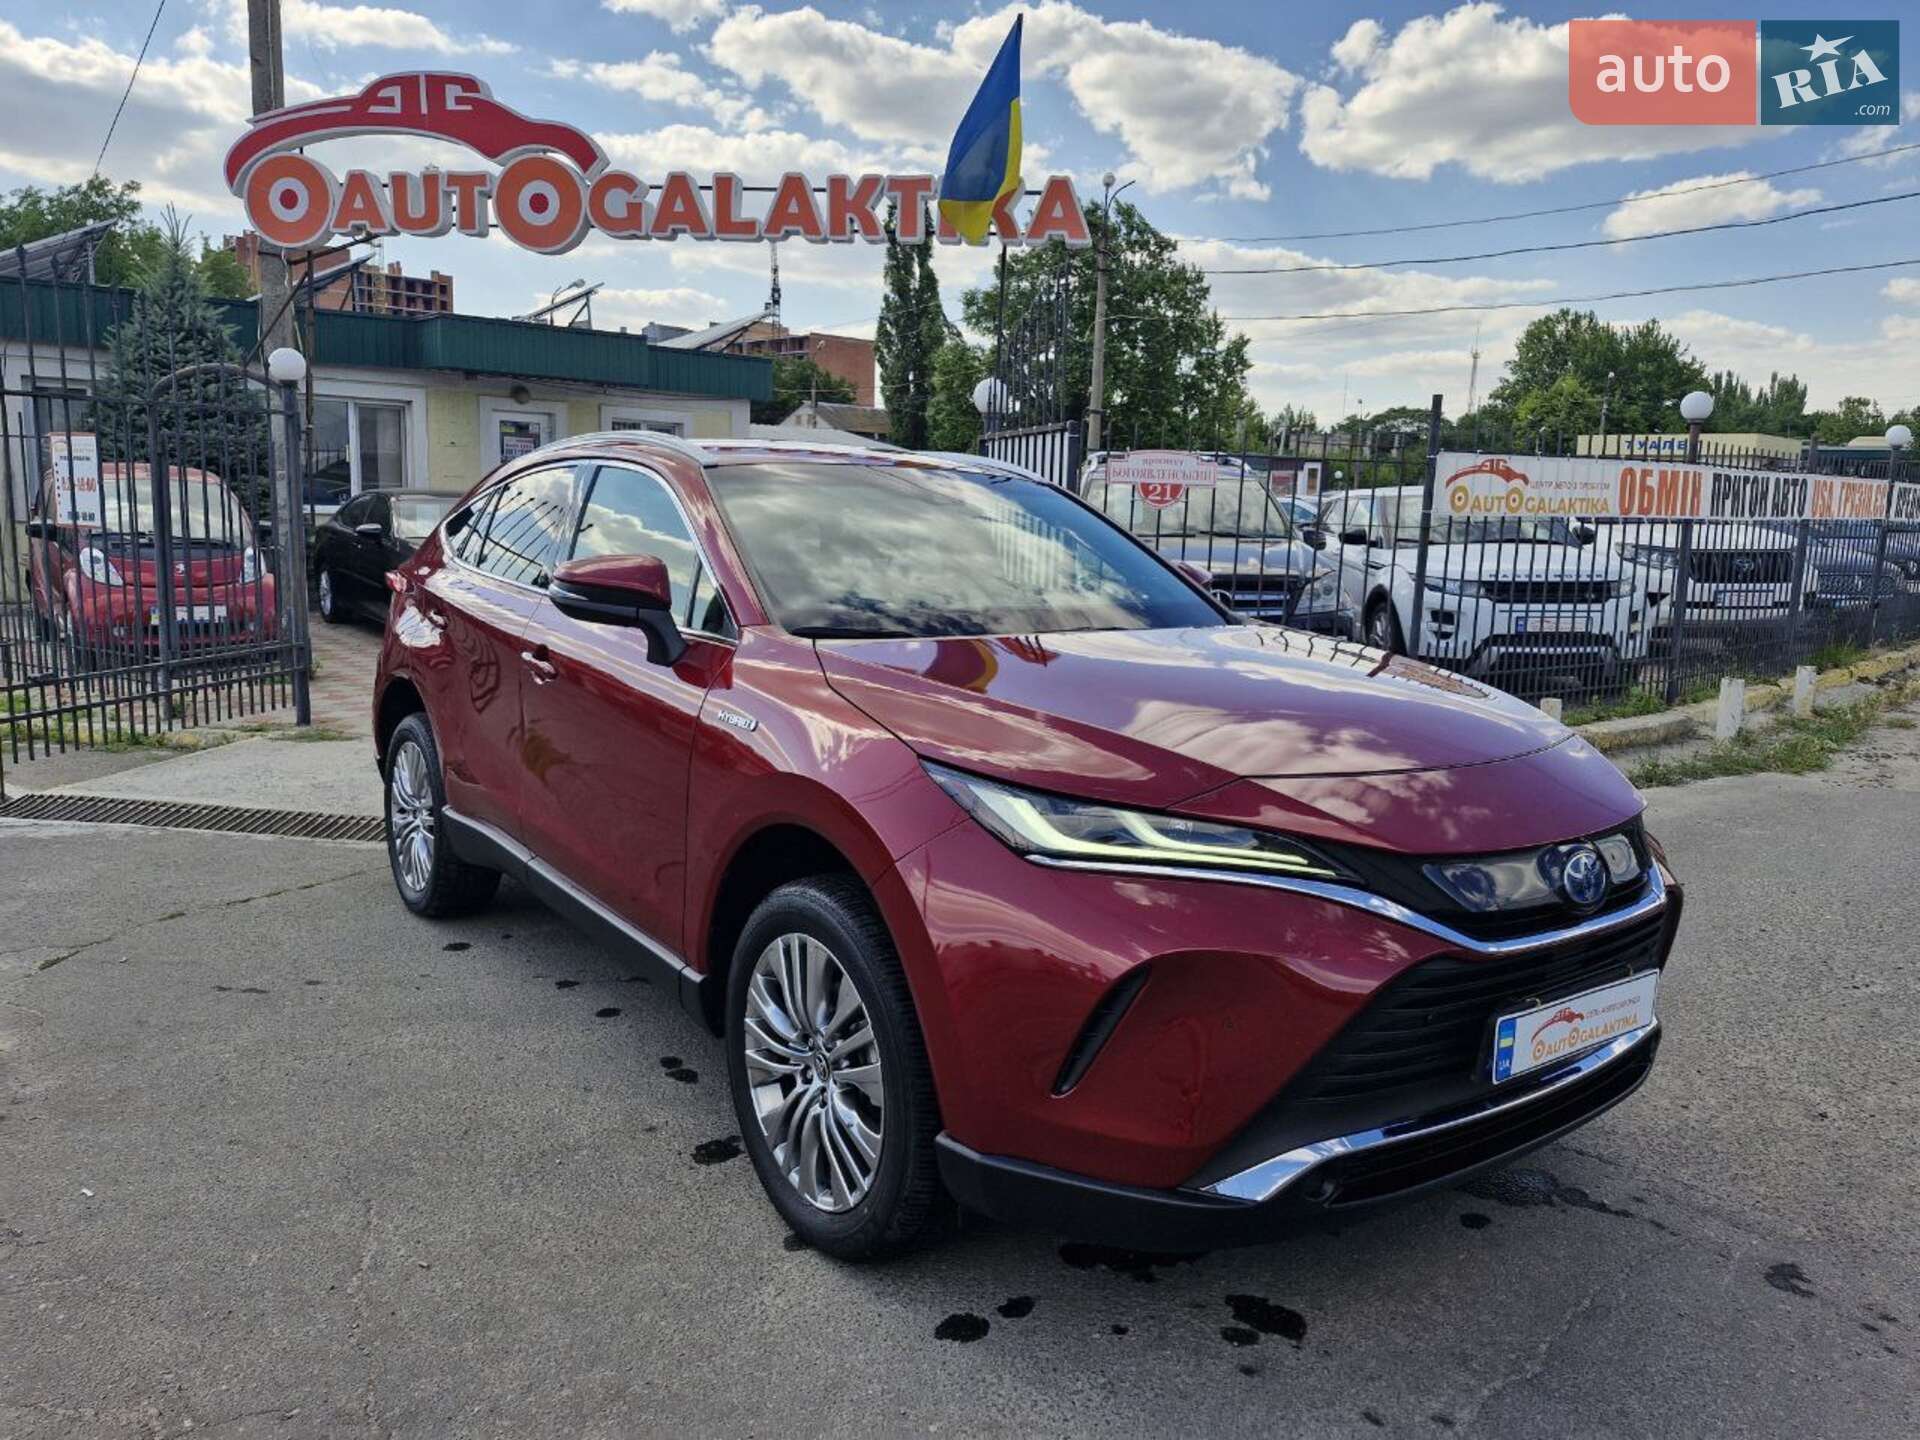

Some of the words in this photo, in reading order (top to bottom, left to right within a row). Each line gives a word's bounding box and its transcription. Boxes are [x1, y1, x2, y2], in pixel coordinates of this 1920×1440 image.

[1148, 484, 1173, 500] 21
[1710, 473, 1770, 518] ПРИГОН
[1771, 477, 1808, 519] АВТО
